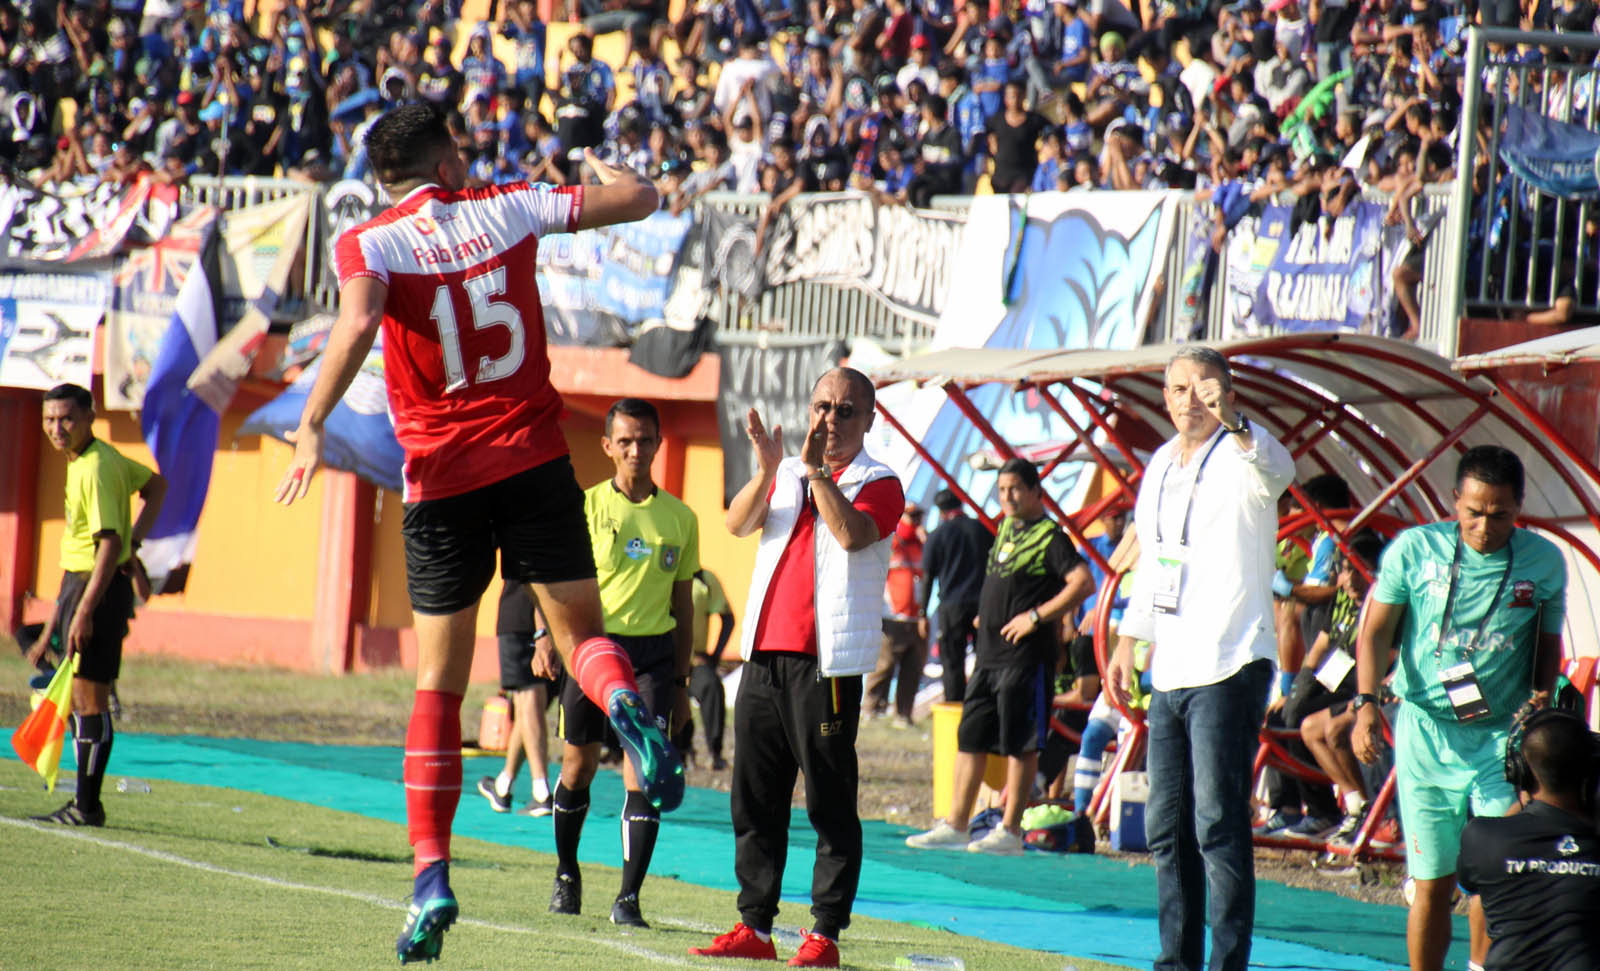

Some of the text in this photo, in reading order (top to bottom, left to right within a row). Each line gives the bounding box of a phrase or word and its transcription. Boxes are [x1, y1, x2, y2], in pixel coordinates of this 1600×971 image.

[412, 232, 494, 267] Fabano
[429, 266, 525, 394] 15
[1506, 860, 1526, 873] TV
